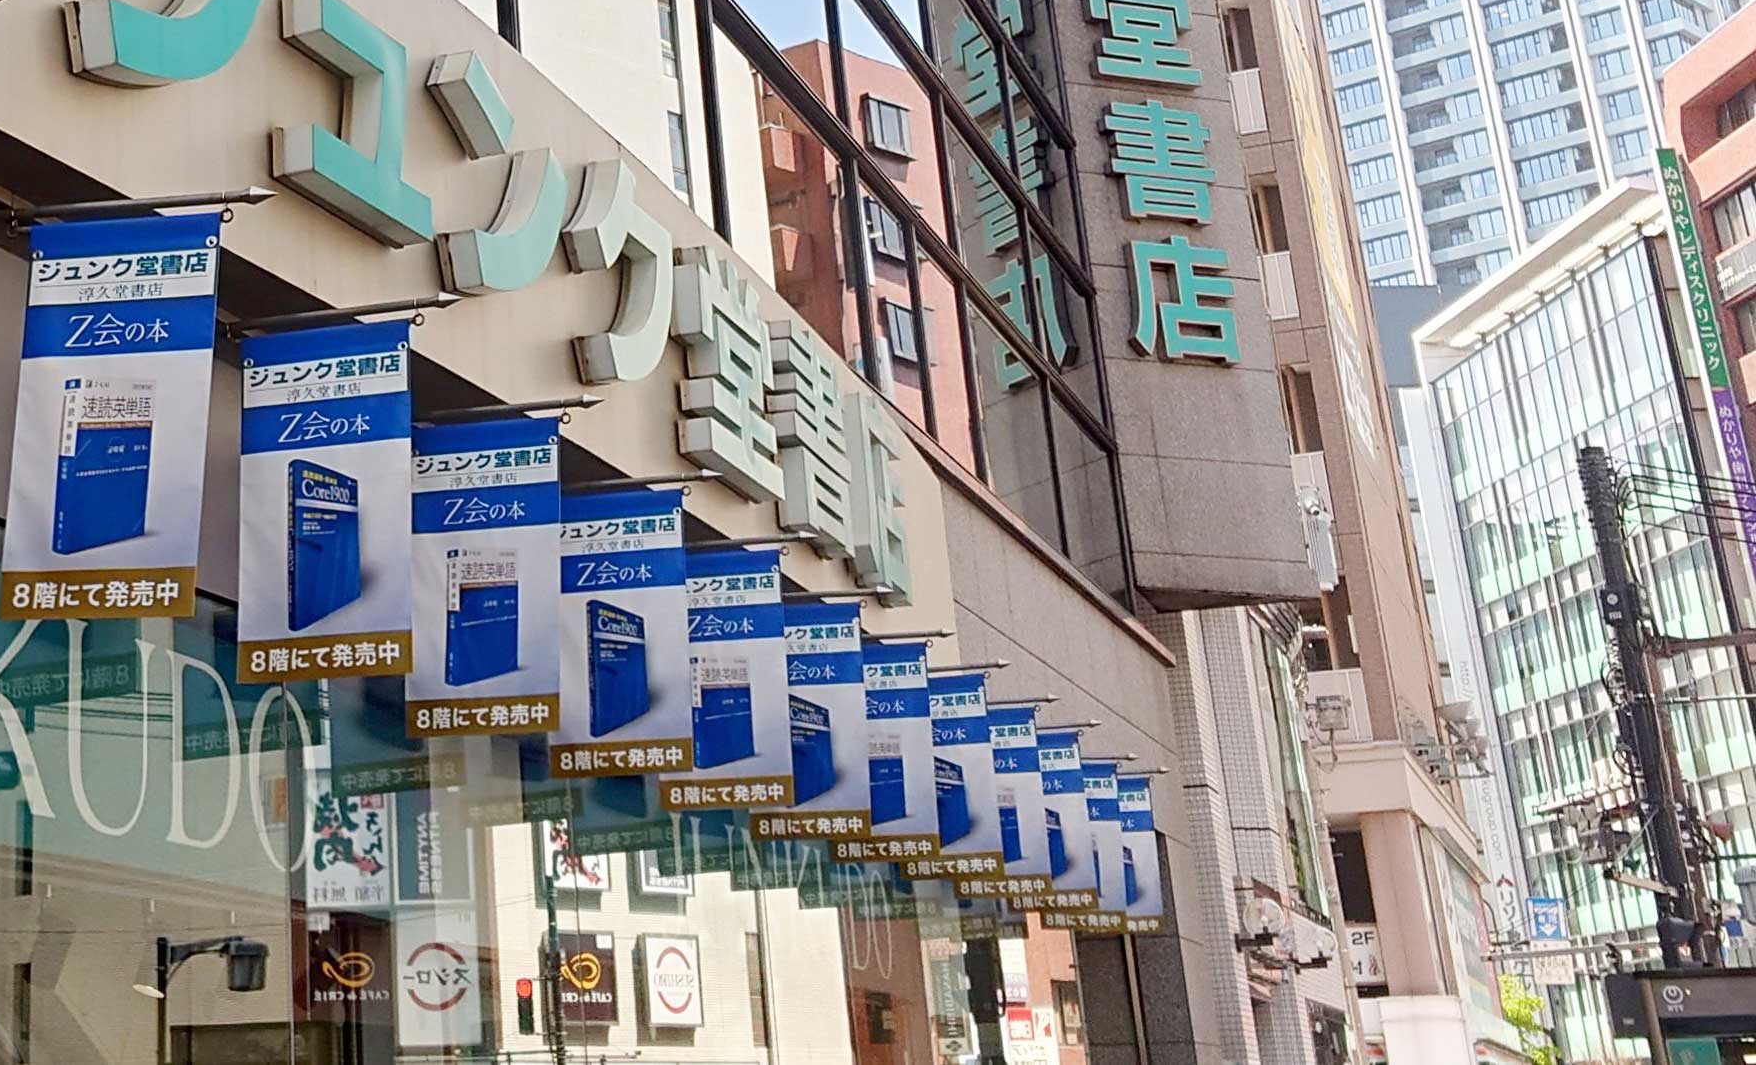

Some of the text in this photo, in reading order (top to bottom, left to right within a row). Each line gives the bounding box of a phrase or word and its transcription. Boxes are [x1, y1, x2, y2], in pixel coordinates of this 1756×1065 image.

[37, 252, 208, 283] ジュンク堂書店
[78, 283, 164, 301] 淳久堂書店
[65, 313, 169, 348] Z会の本
[249, 353, 401, 387] ジュンク堂書店
[286, 383, 362, 403] 淳久堂書店
[81, 396, 152, 420] 速読英単語
[277, 410, 370, 444] Z会の本
[416, 448, 552, 474] ジュンク堂書店
[449, 473, 517, 489] 淳久堂書店
[444, 497, 525, 526] Z会の本
[577, 561, 652, 586] Z会の本
[12, 580, 179, 610] 8階にて発売中
[688, 614, 754, 636] Z会の本
[250, 640, 401, 673] 8階にて発売中
[788, 661, 835, 681] 会の本
[866, 664, 922, 677] ク堂書店
[416, 702, 549, 729] 8階にて発売中
[866, 698, 905, 715] 会の本
[560, 746, 683, 771] 8階にて発売中
[670, 784, 784, 804] 8階にて発売中
[759, 816, 863, 835] 8階にて発売中
[837, 839, 932, 857] 8階にて発売中
[906, 858, 997, 876] 8階にて発売中
[960, 876, 1045, 894] 8階にて発売中
[1013, 894, 1092, 909] 8階にて発売中
[1046, 912, 1121, 927] 8階にて発売中
